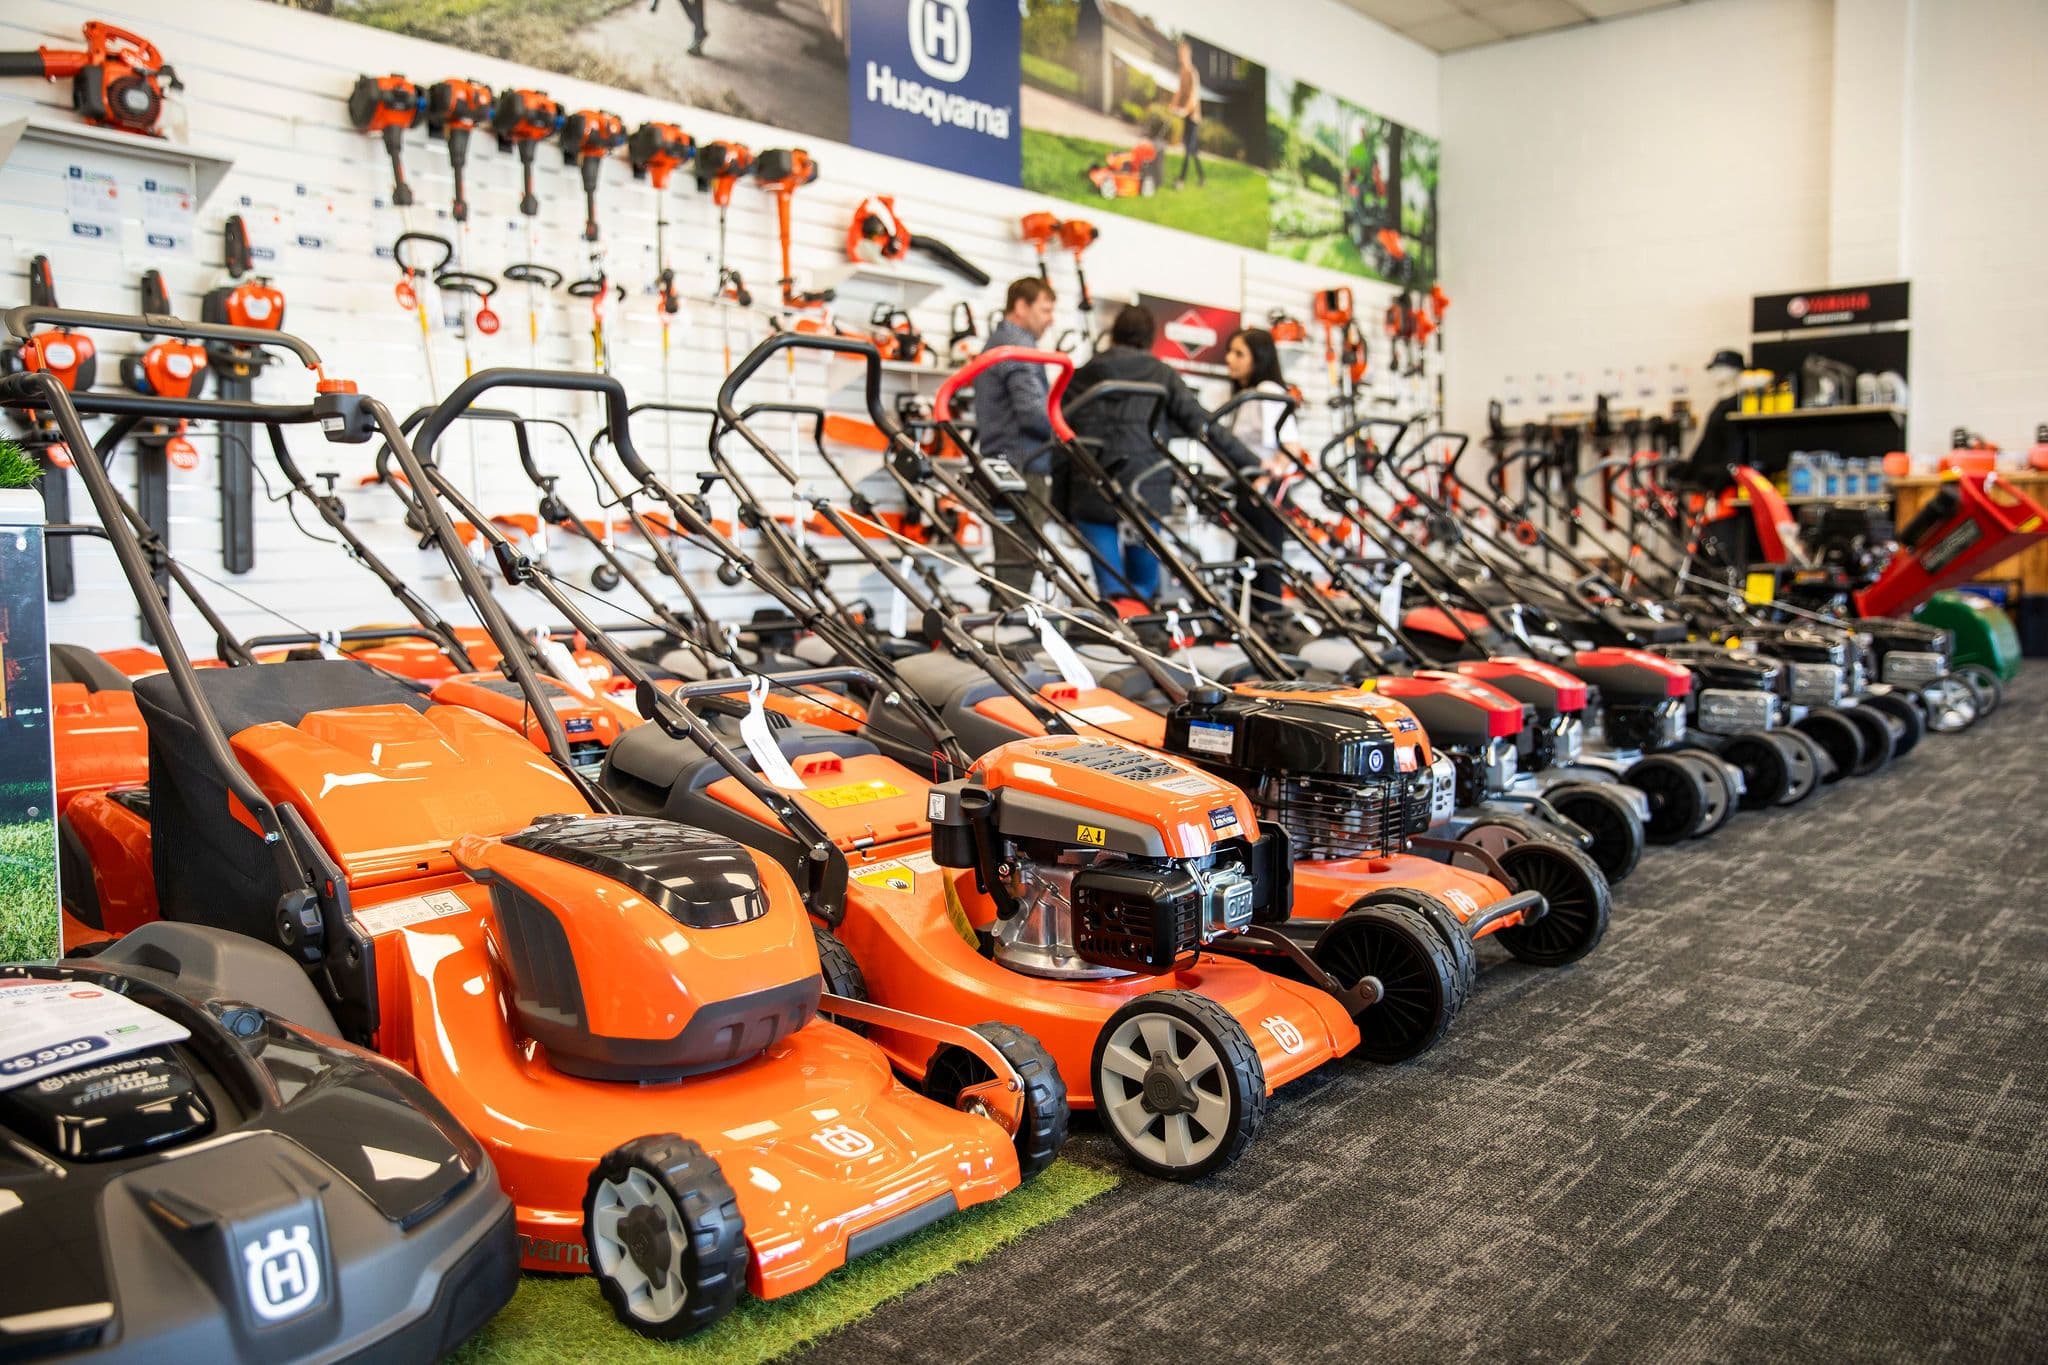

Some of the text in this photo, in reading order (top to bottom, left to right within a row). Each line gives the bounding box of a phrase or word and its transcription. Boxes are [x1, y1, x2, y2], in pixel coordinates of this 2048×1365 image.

[866, 61, 1009, 139] Husqvarna
[434, 902, 454, 914] 95
[62, 1056, 165, 1085] Husqvarna
